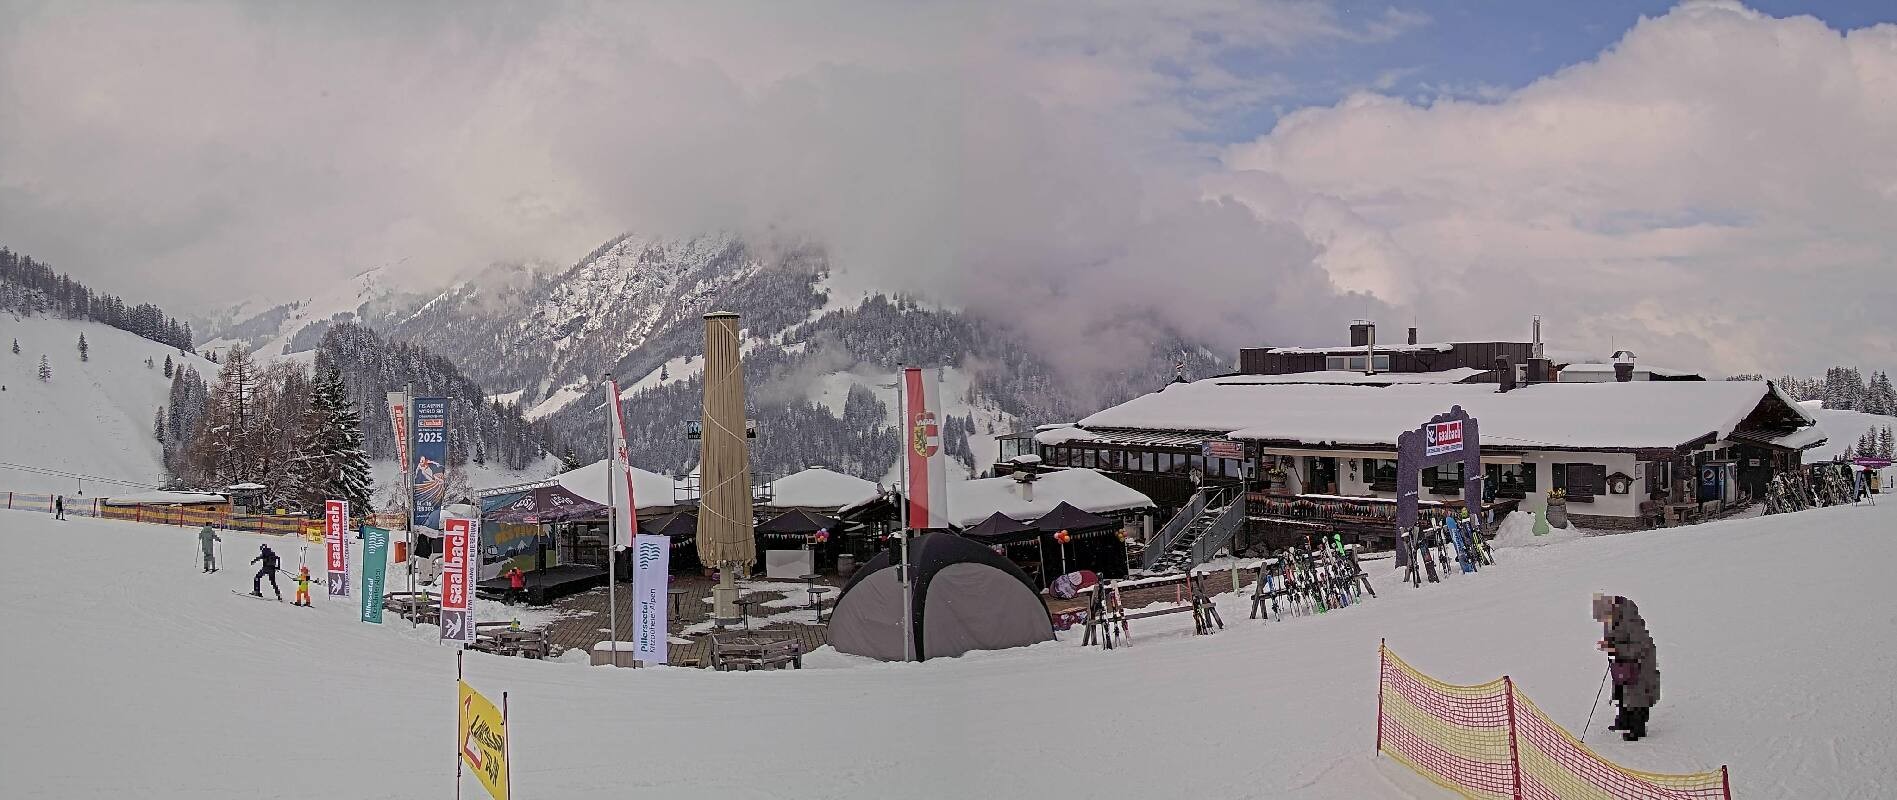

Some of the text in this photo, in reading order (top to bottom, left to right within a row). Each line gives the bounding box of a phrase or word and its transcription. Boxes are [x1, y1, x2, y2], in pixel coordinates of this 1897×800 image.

[418, 432, 443, 443] 2025
[326, 505, 341, 568] saalbach
[444, 525, 465, 604] saalbach
